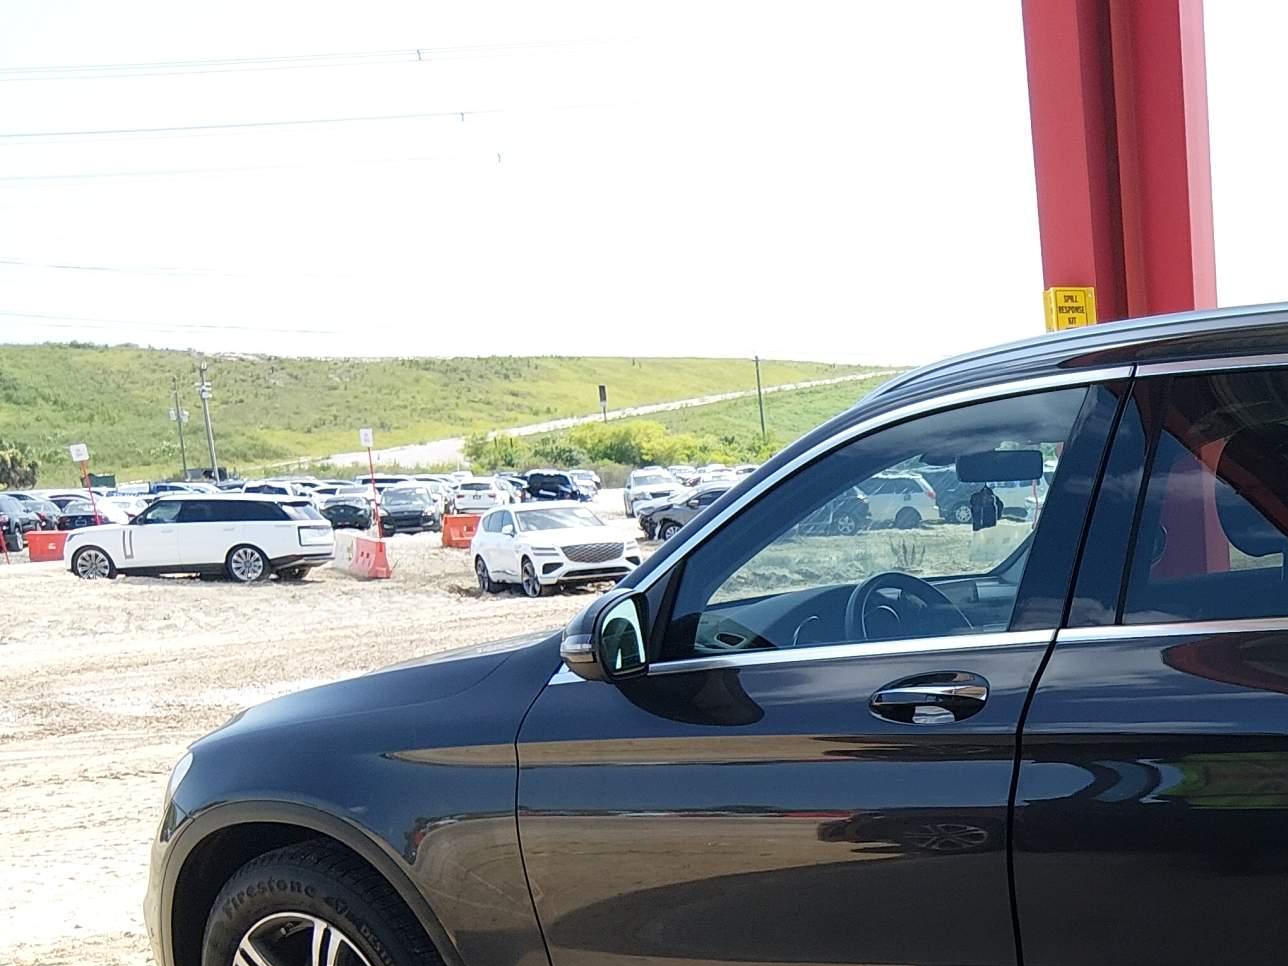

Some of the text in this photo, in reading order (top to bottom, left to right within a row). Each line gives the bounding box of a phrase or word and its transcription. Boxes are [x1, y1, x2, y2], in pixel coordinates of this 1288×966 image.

[1063, 294, 1078, 303] SPILL
[1058, 305, 1085, 314] RESPONSE
[1067, 316, 1077, 325] KIT
